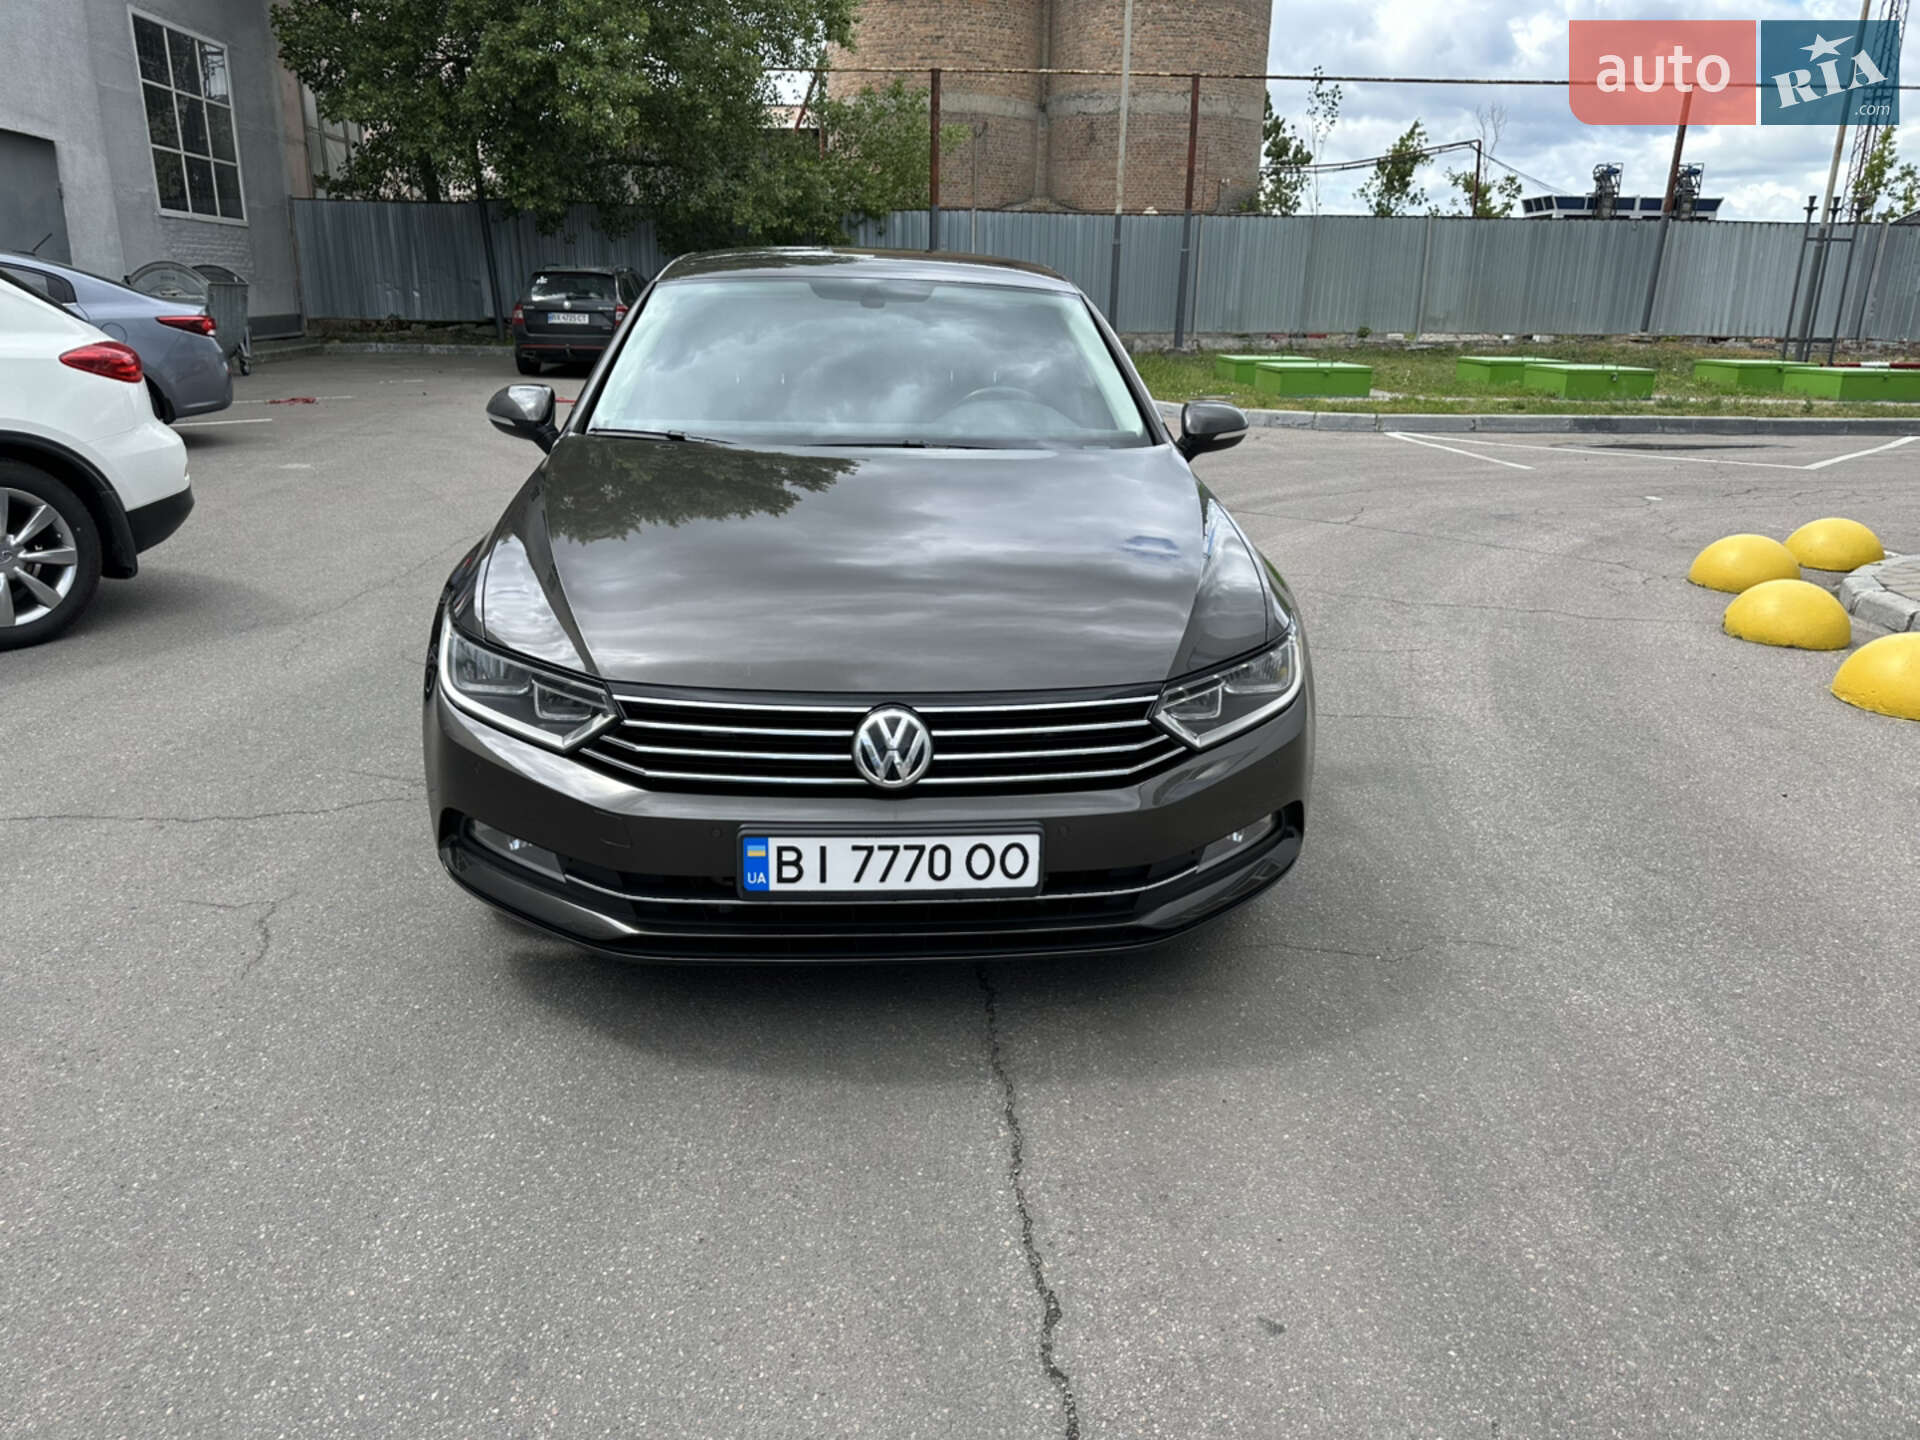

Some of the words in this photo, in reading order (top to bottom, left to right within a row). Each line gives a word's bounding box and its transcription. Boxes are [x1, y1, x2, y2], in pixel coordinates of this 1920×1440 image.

[776, 845, 827, 884] BI
[851, 843, 951, 883] 7770
[965, 842, 1029, 880] OO
[747, 872, 767, 884] UA
